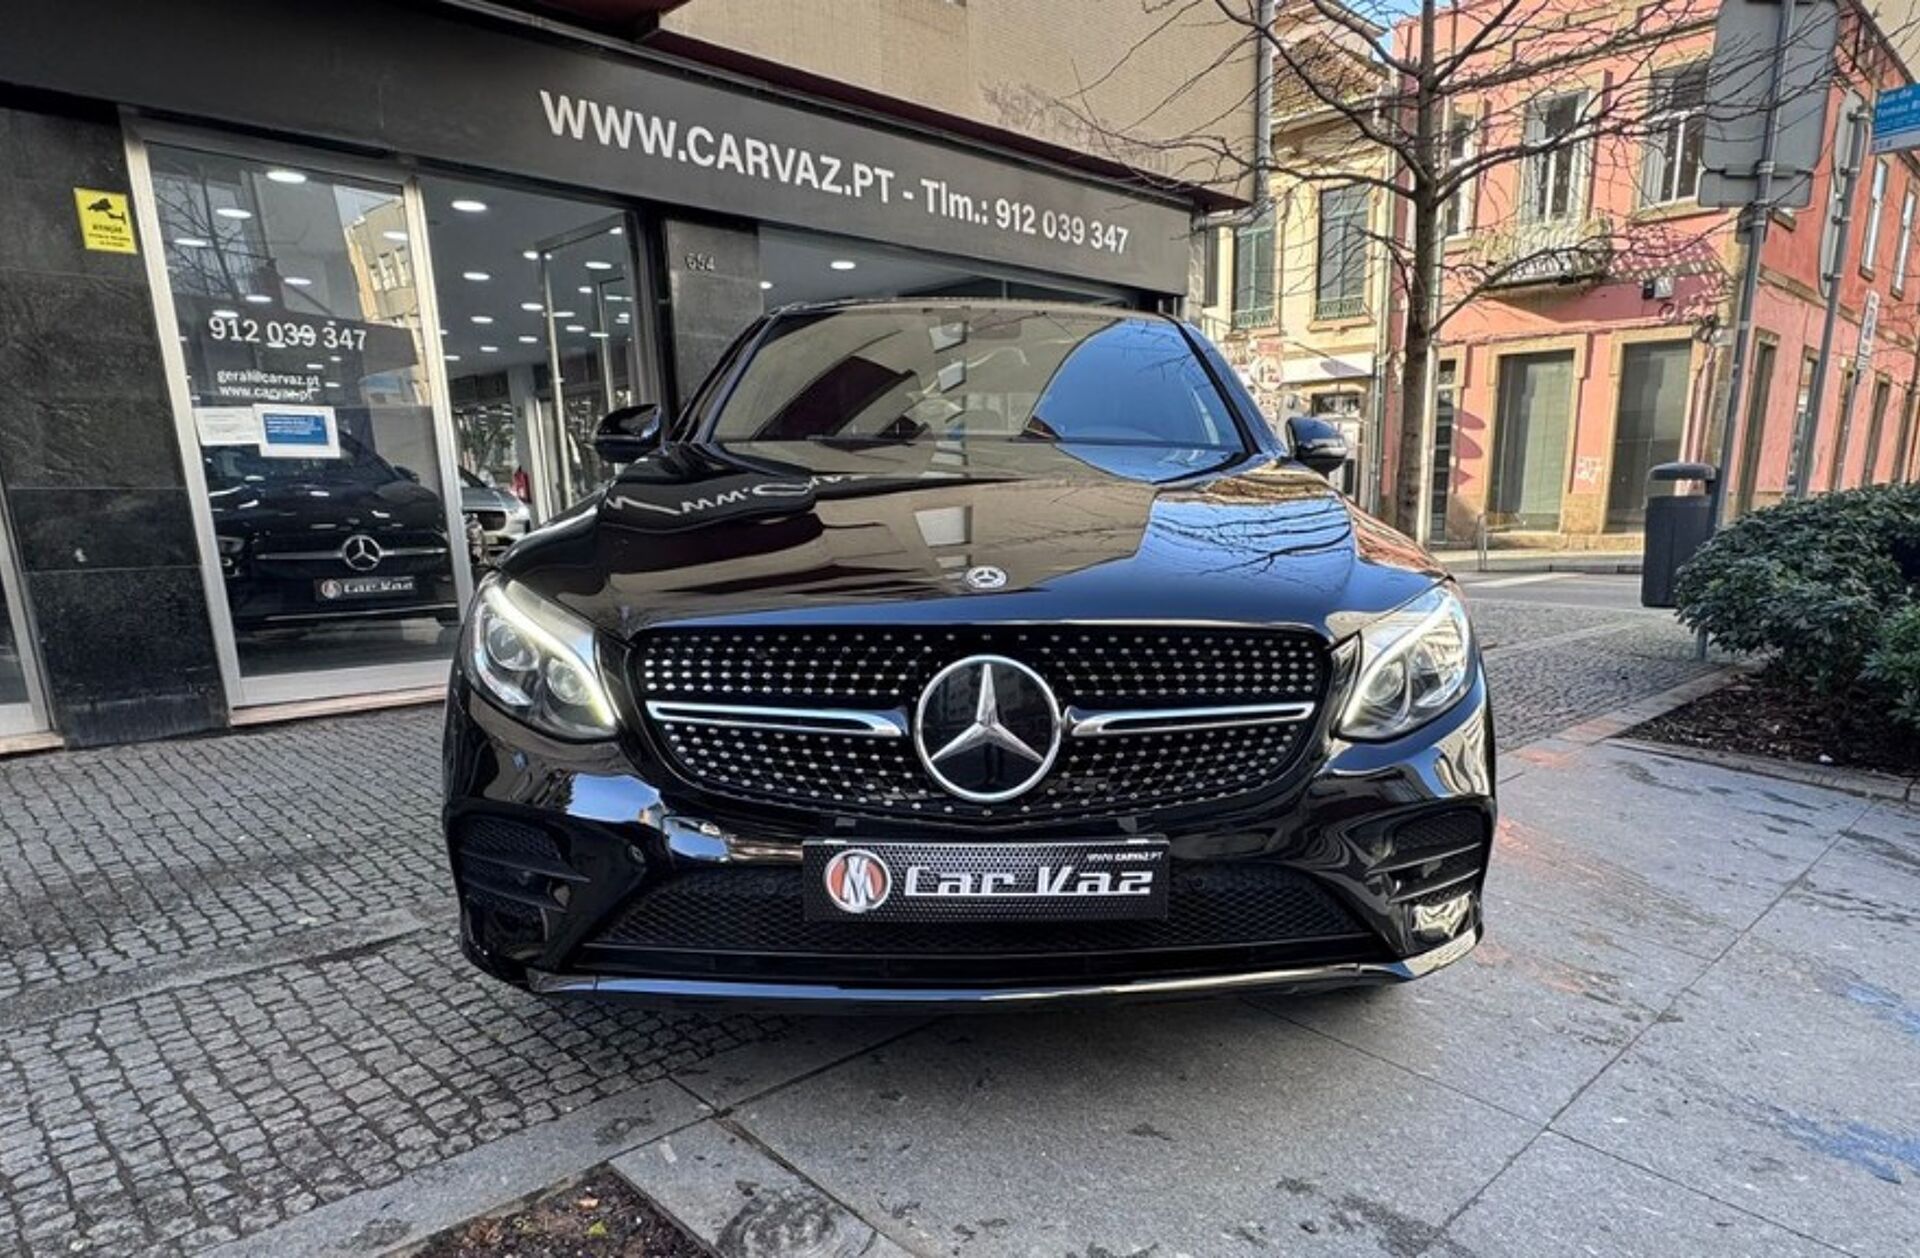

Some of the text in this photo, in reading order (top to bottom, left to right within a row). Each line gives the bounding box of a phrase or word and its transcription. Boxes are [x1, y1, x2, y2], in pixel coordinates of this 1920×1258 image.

[540, 90, 894, 204] WWW.CARVAZ.PT
[920, 178, 988, 226] Tlm.:
[995, 198, 1036, 235] 912
[1042, 208, 1085, 246] 039
[1090, 219, 1129, 254] 347
[208, 316, 367, 350] 912 039 347
